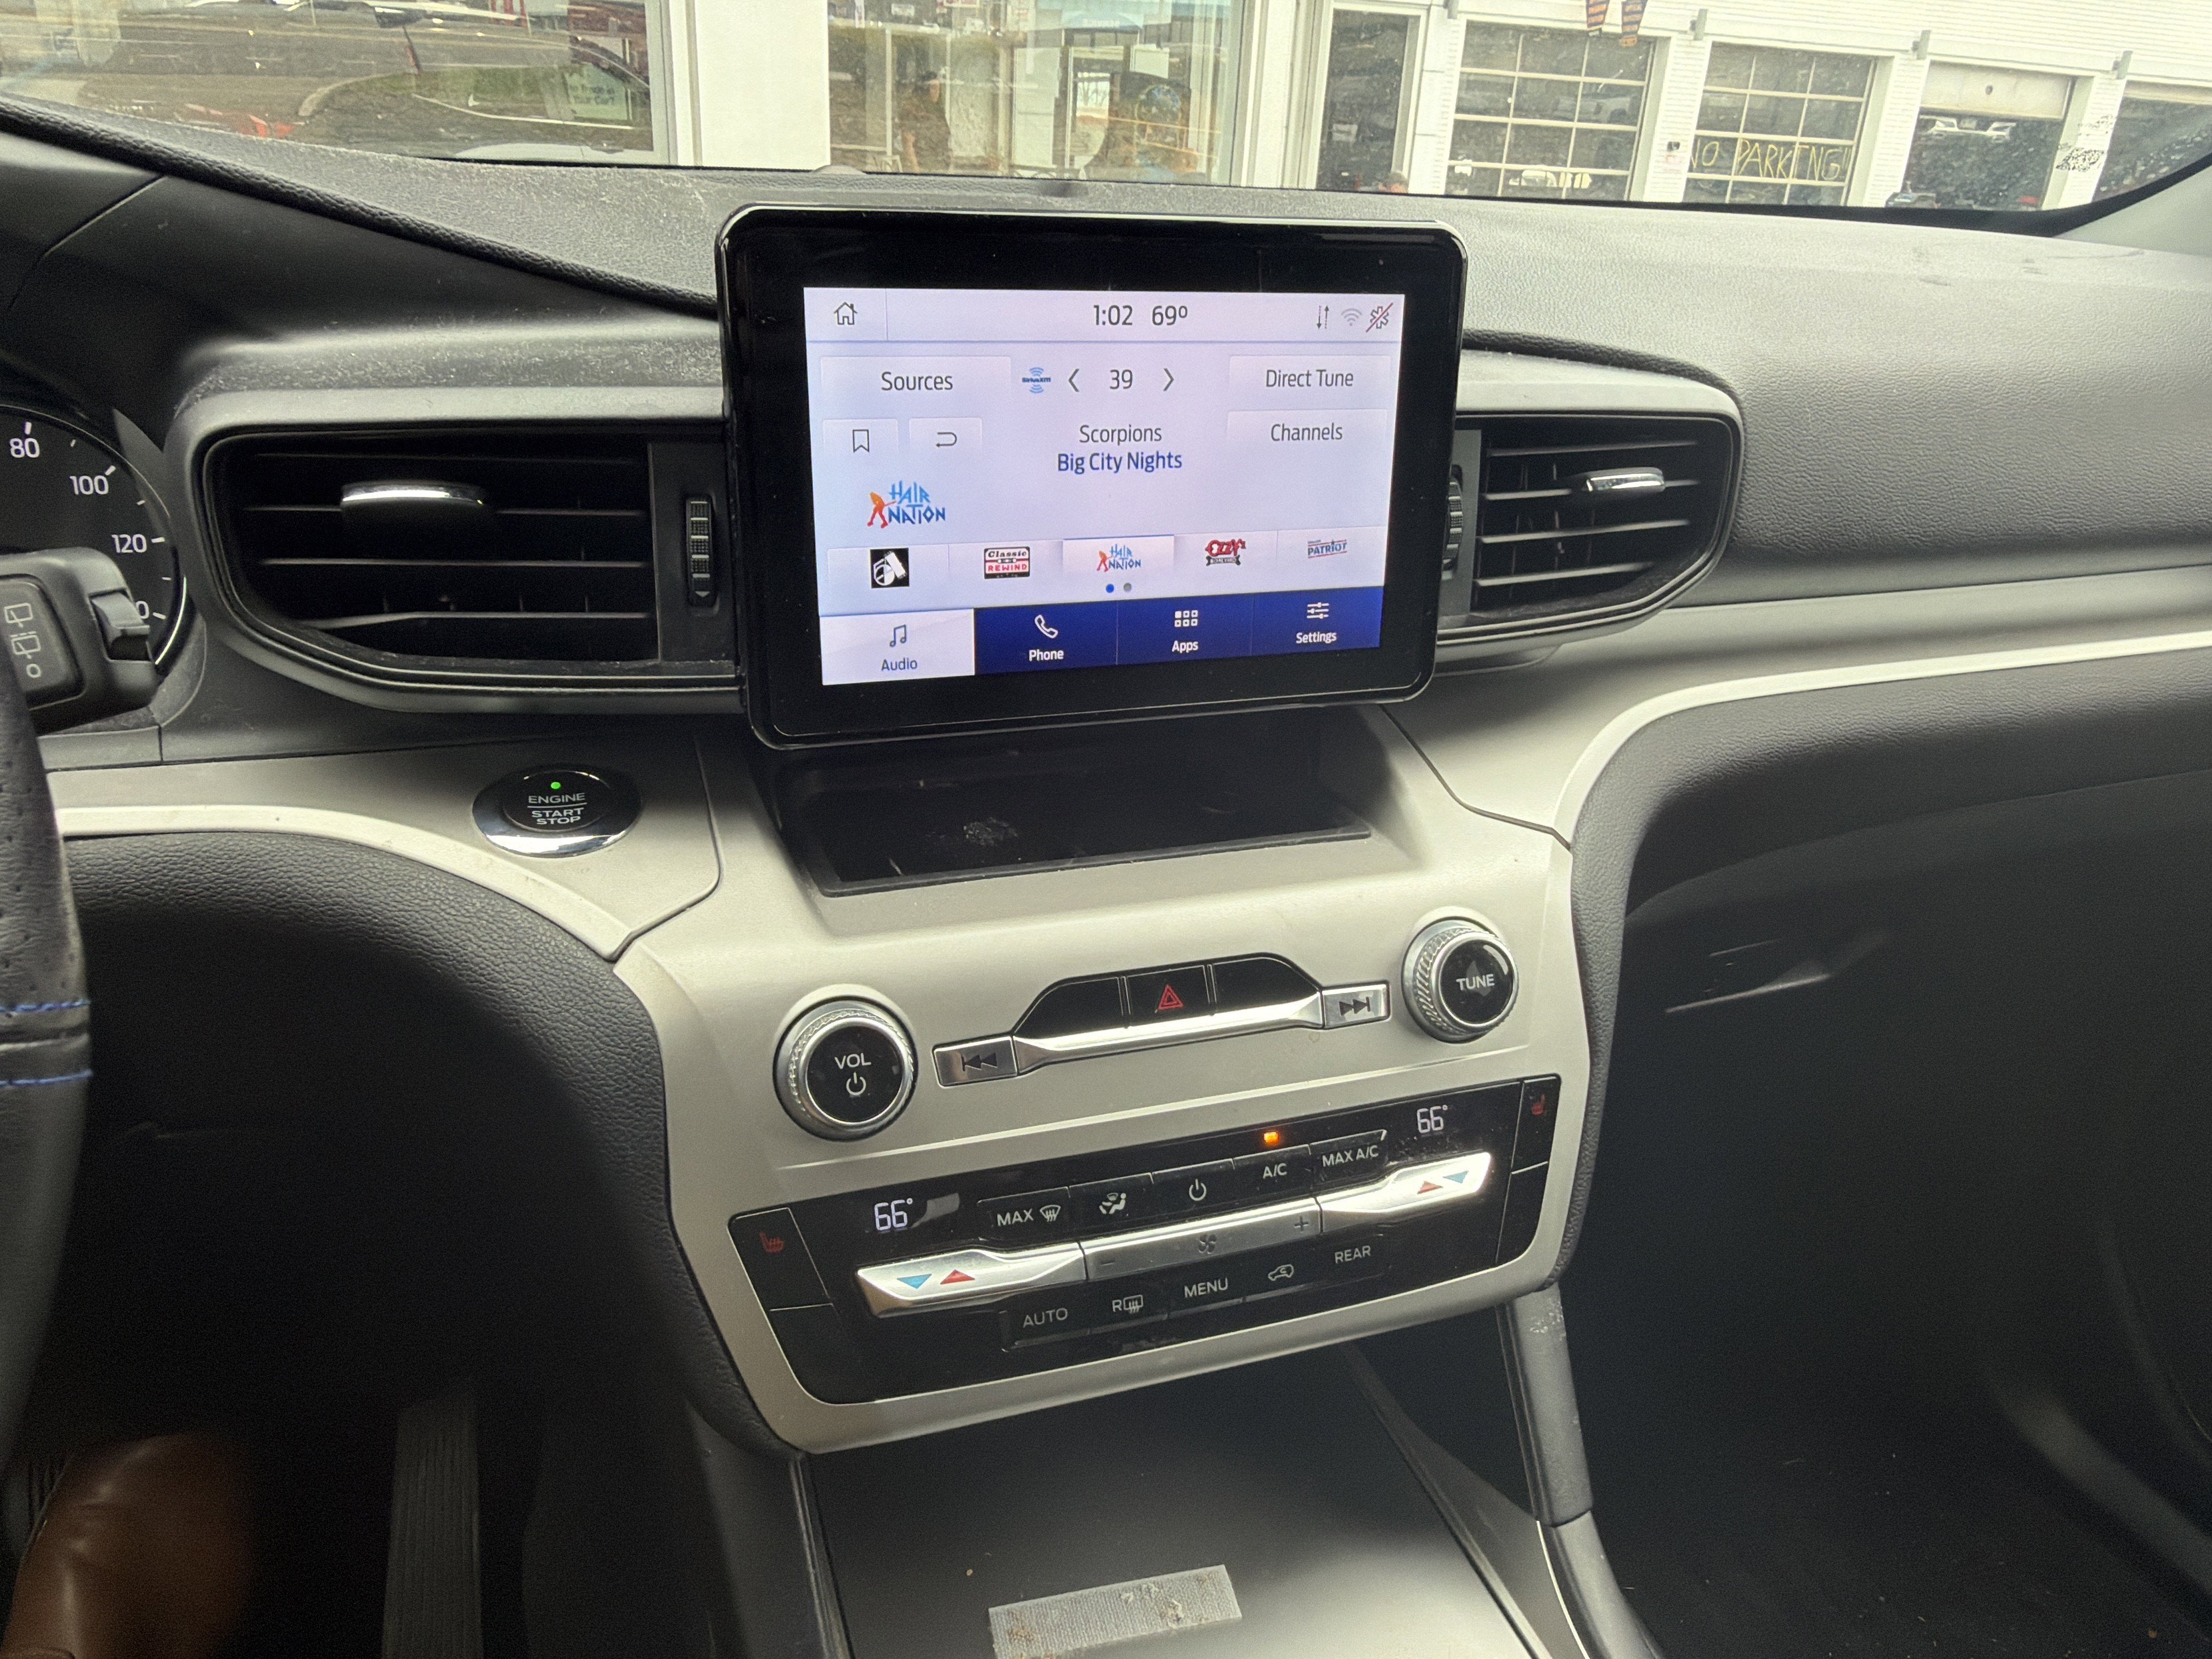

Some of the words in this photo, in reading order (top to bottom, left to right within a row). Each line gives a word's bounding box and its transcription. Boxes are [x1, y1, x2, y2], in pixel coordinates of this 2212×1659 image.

[1094, 305, 1132, 325] 1:02
[882, 371, 952, 391] Sources
[1110, 369, 1132, 390] 39
[1266, 370, 1311, 387] Direct
[1316, 369, 1353, 386] Tune
[1080, 425, 1161, 445] Scorpions
[1271, 423, 1342, 441] Channels
[10, 438, 40, 458] 80
[1058, 454, 1085, 475] Big
[1090, 453, 1122, 473] City
[1128, 451, 1182, 472] Nights
[70, 476, 109, 495] 100
[888, 480, 932, 504] HAIR
[888, 504, 946, 524] NATION
[112, 534, 146, 552] 120
[1110, 544, 1133, 558] HAIR
[1308, 542, 1347, 556] PATRIOT
[1109, 557, 1141, 569] NATION
[1172, 641, 1198, 653] Apps
[1296, 632, 1336, 644] Settings
[882, 658, 917, 670] Audio
[1029, 649, 1064, 661] Phone
[528, 793, 586, 804] ENGINE
[532, 807, 584, 817] START
[536, 816, 581, 825] STOP
[1455, 973, 1495, 991] TUNE
[835, 1053, 871, 1069] VOL
[1323, 1150, 1353, 1166] MAX
[1356, 1146, 1378, 1160] A/C
[1263, 1163, 1286, 1178] A/C
[997, 1209, 1033, 1226] MAX
[1335, 1245, 1370, 1263] REAR
[1184, 1278, 1228, 1297] MENU
[1113, 1300, 1122, 1312] R
[1023, 1308, 1068, 1328] AUTO
